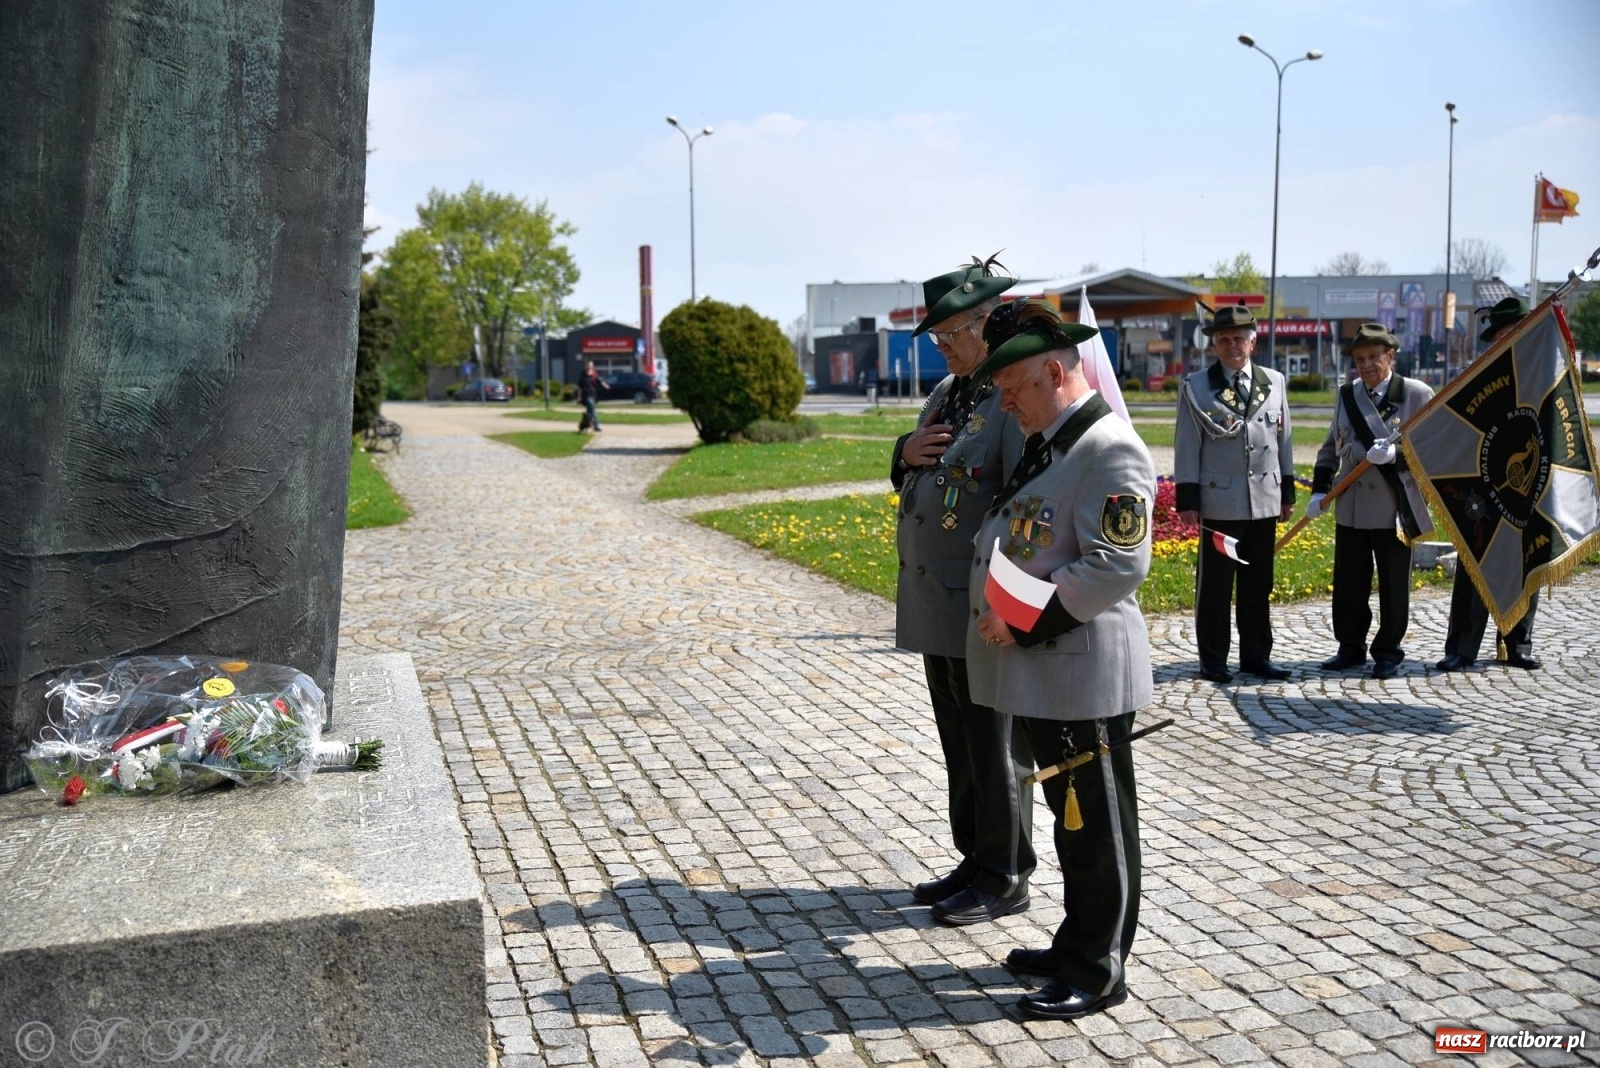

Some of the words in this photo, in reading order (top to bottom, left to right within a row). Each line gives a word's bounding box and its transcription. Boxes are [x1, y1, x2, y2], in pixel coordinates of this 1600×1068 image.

[1256, 323, 1327, 334] ESAURACJA
[1466, 375, 1511, 415] STANMY
[1506, 408, 1545, 447] RACIBOKIE
[1555, 396, 1576, 460] BRACIA
[1481, 425, 1499, 483] BRACTWO
